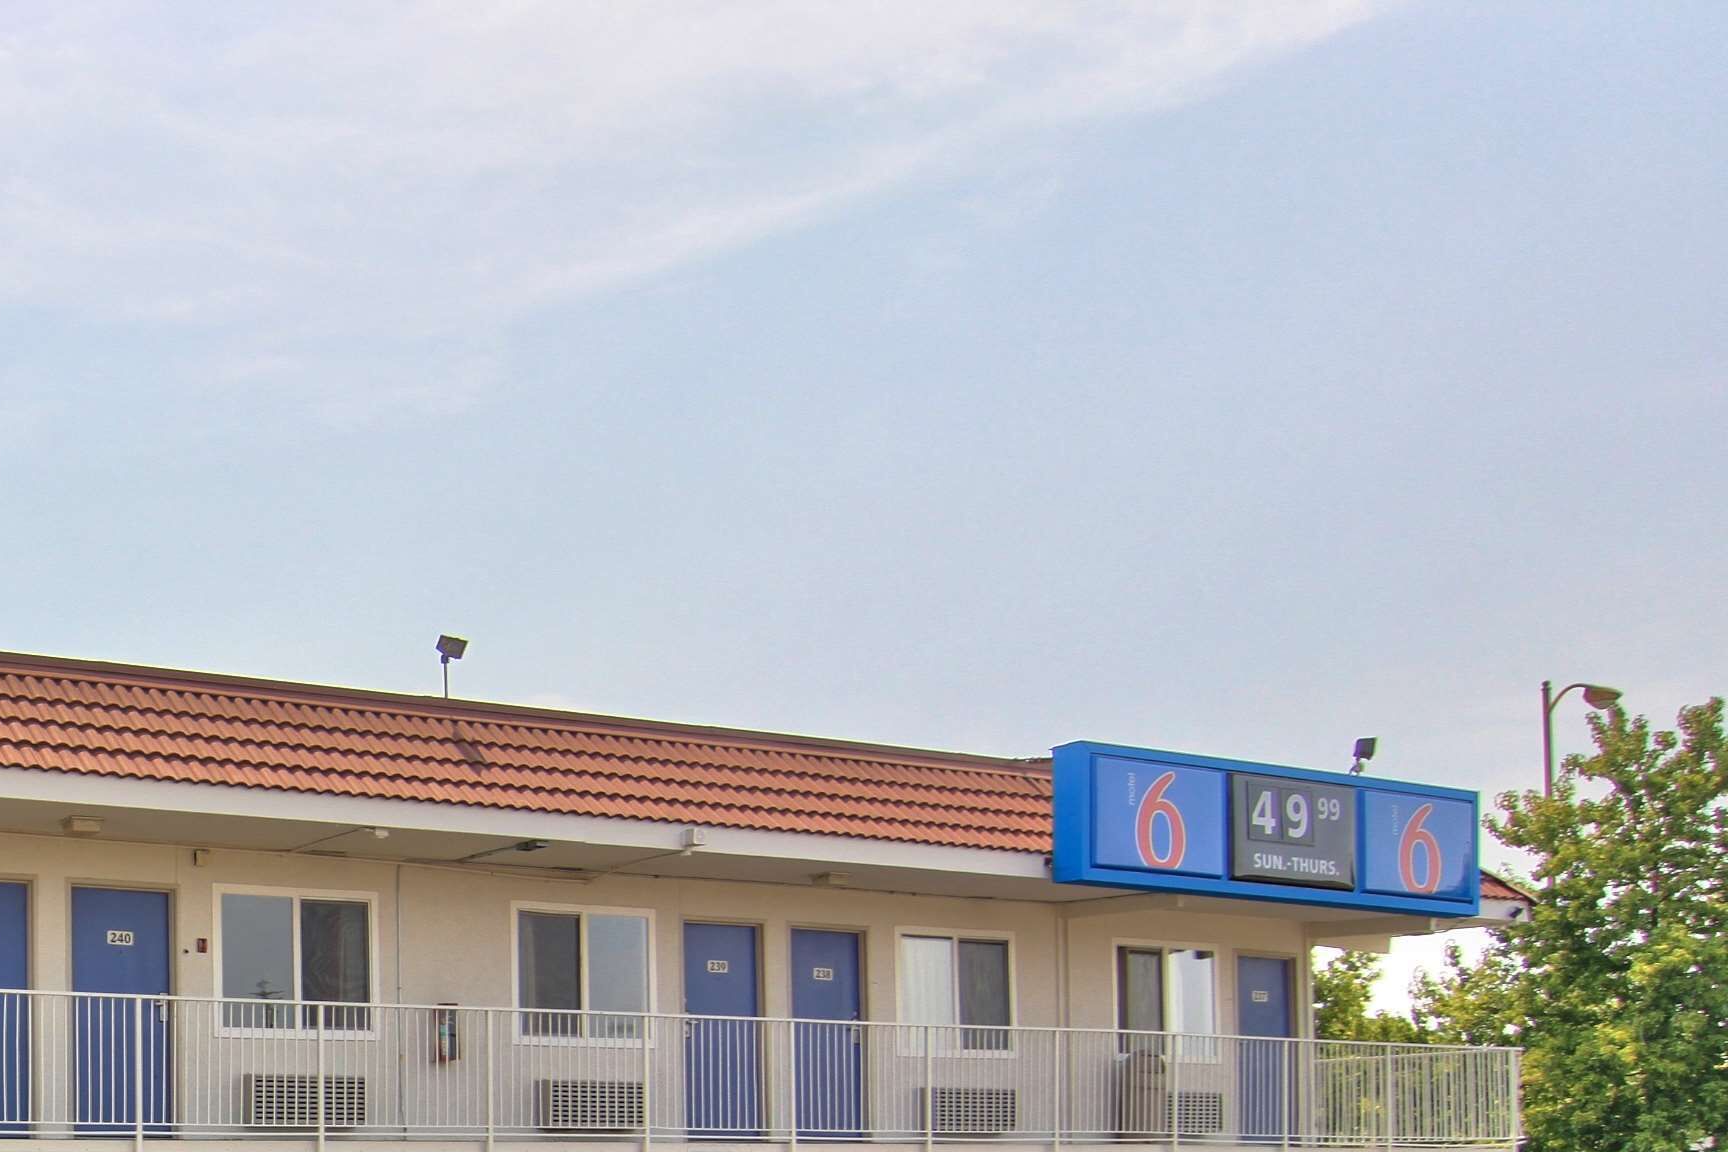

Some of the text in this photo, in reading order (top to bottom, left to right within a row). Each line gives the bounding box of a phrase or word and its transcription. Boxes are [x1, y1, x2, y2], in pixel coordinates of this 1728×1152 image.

[1128, 770, 1186, 869] motel 6
[1252, 790, 1340, 838] 49 99
[1254, 852, 1340, 876] SUN.-THURS.
[1398, 802, 1442, 894] 6
[109, 932, 132, 944] 240
